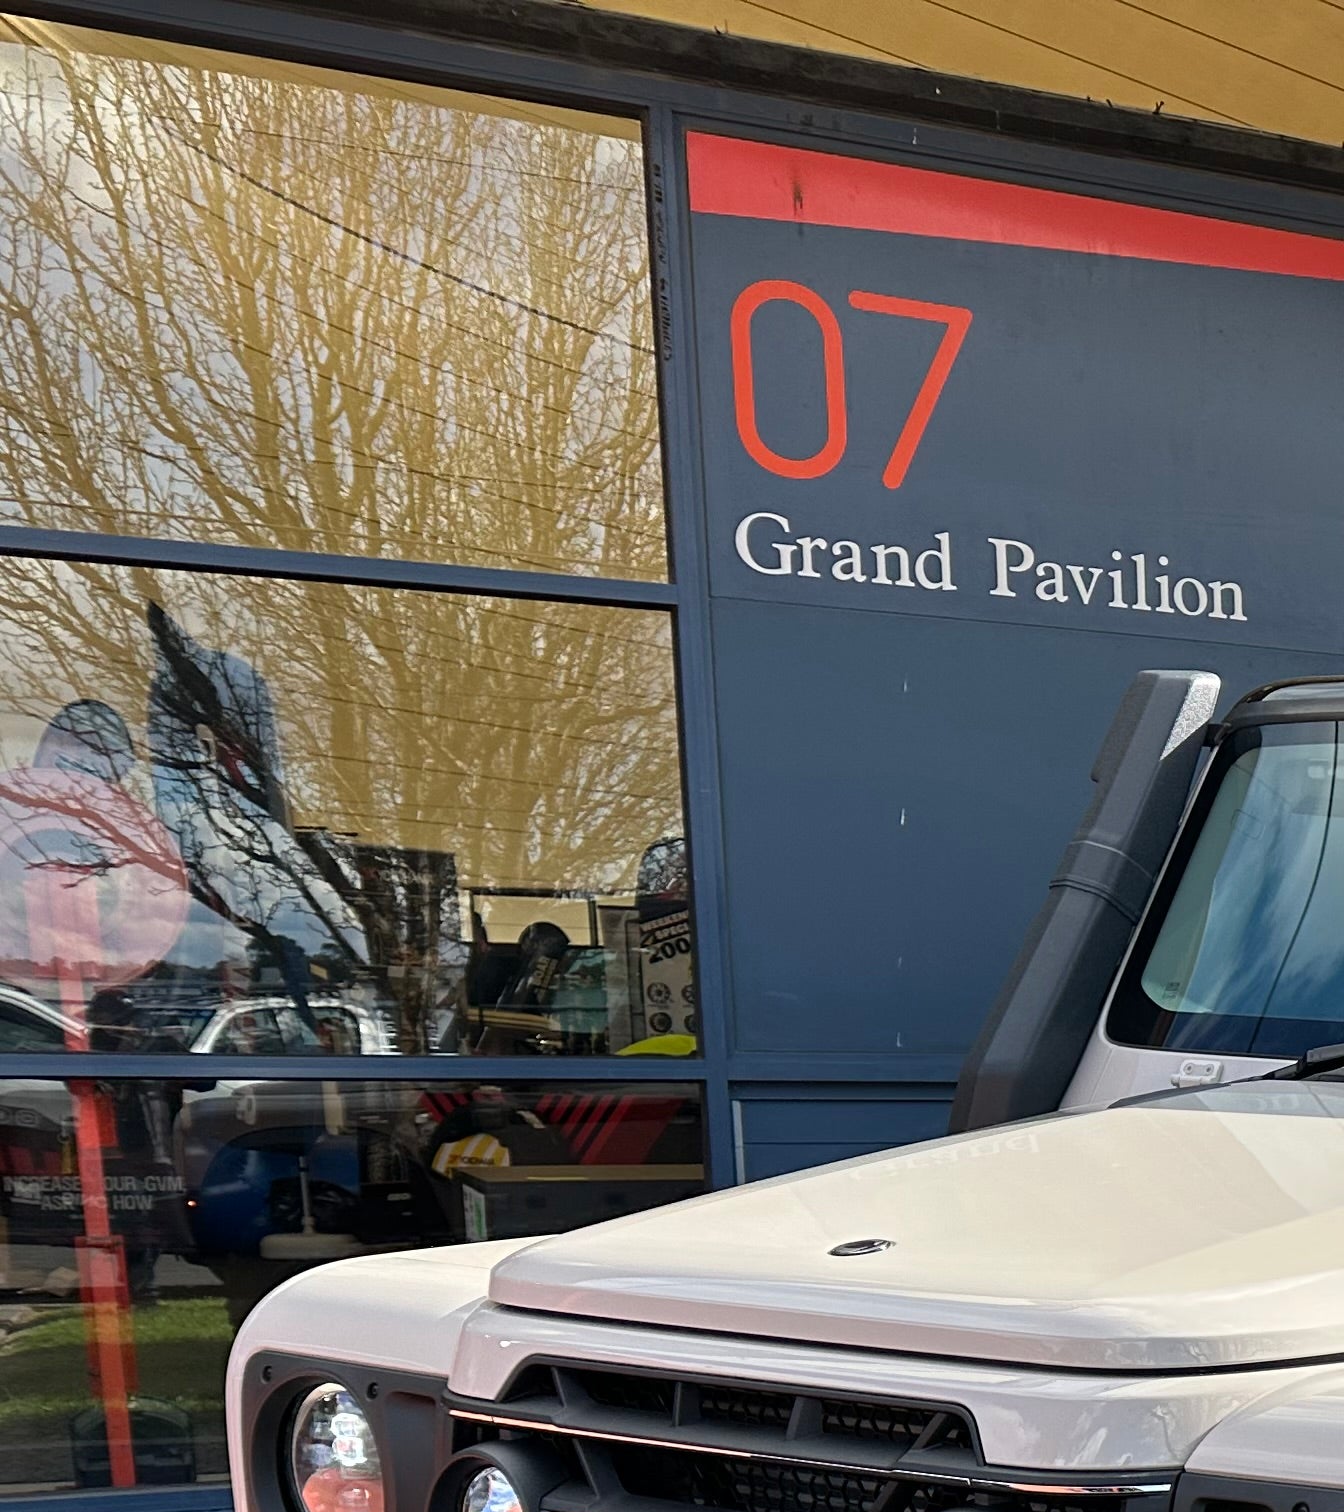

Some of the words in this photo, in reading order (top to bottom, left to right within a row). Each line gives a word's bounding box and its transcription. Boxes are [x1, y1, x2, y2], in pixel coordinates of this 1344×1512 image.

[730, 279, 973, 490] 07
[734, 511, 958, 592] Grand
[987, 536, 1248, 622] Pavilion
[113, 1194, 153, 1211] HOW
